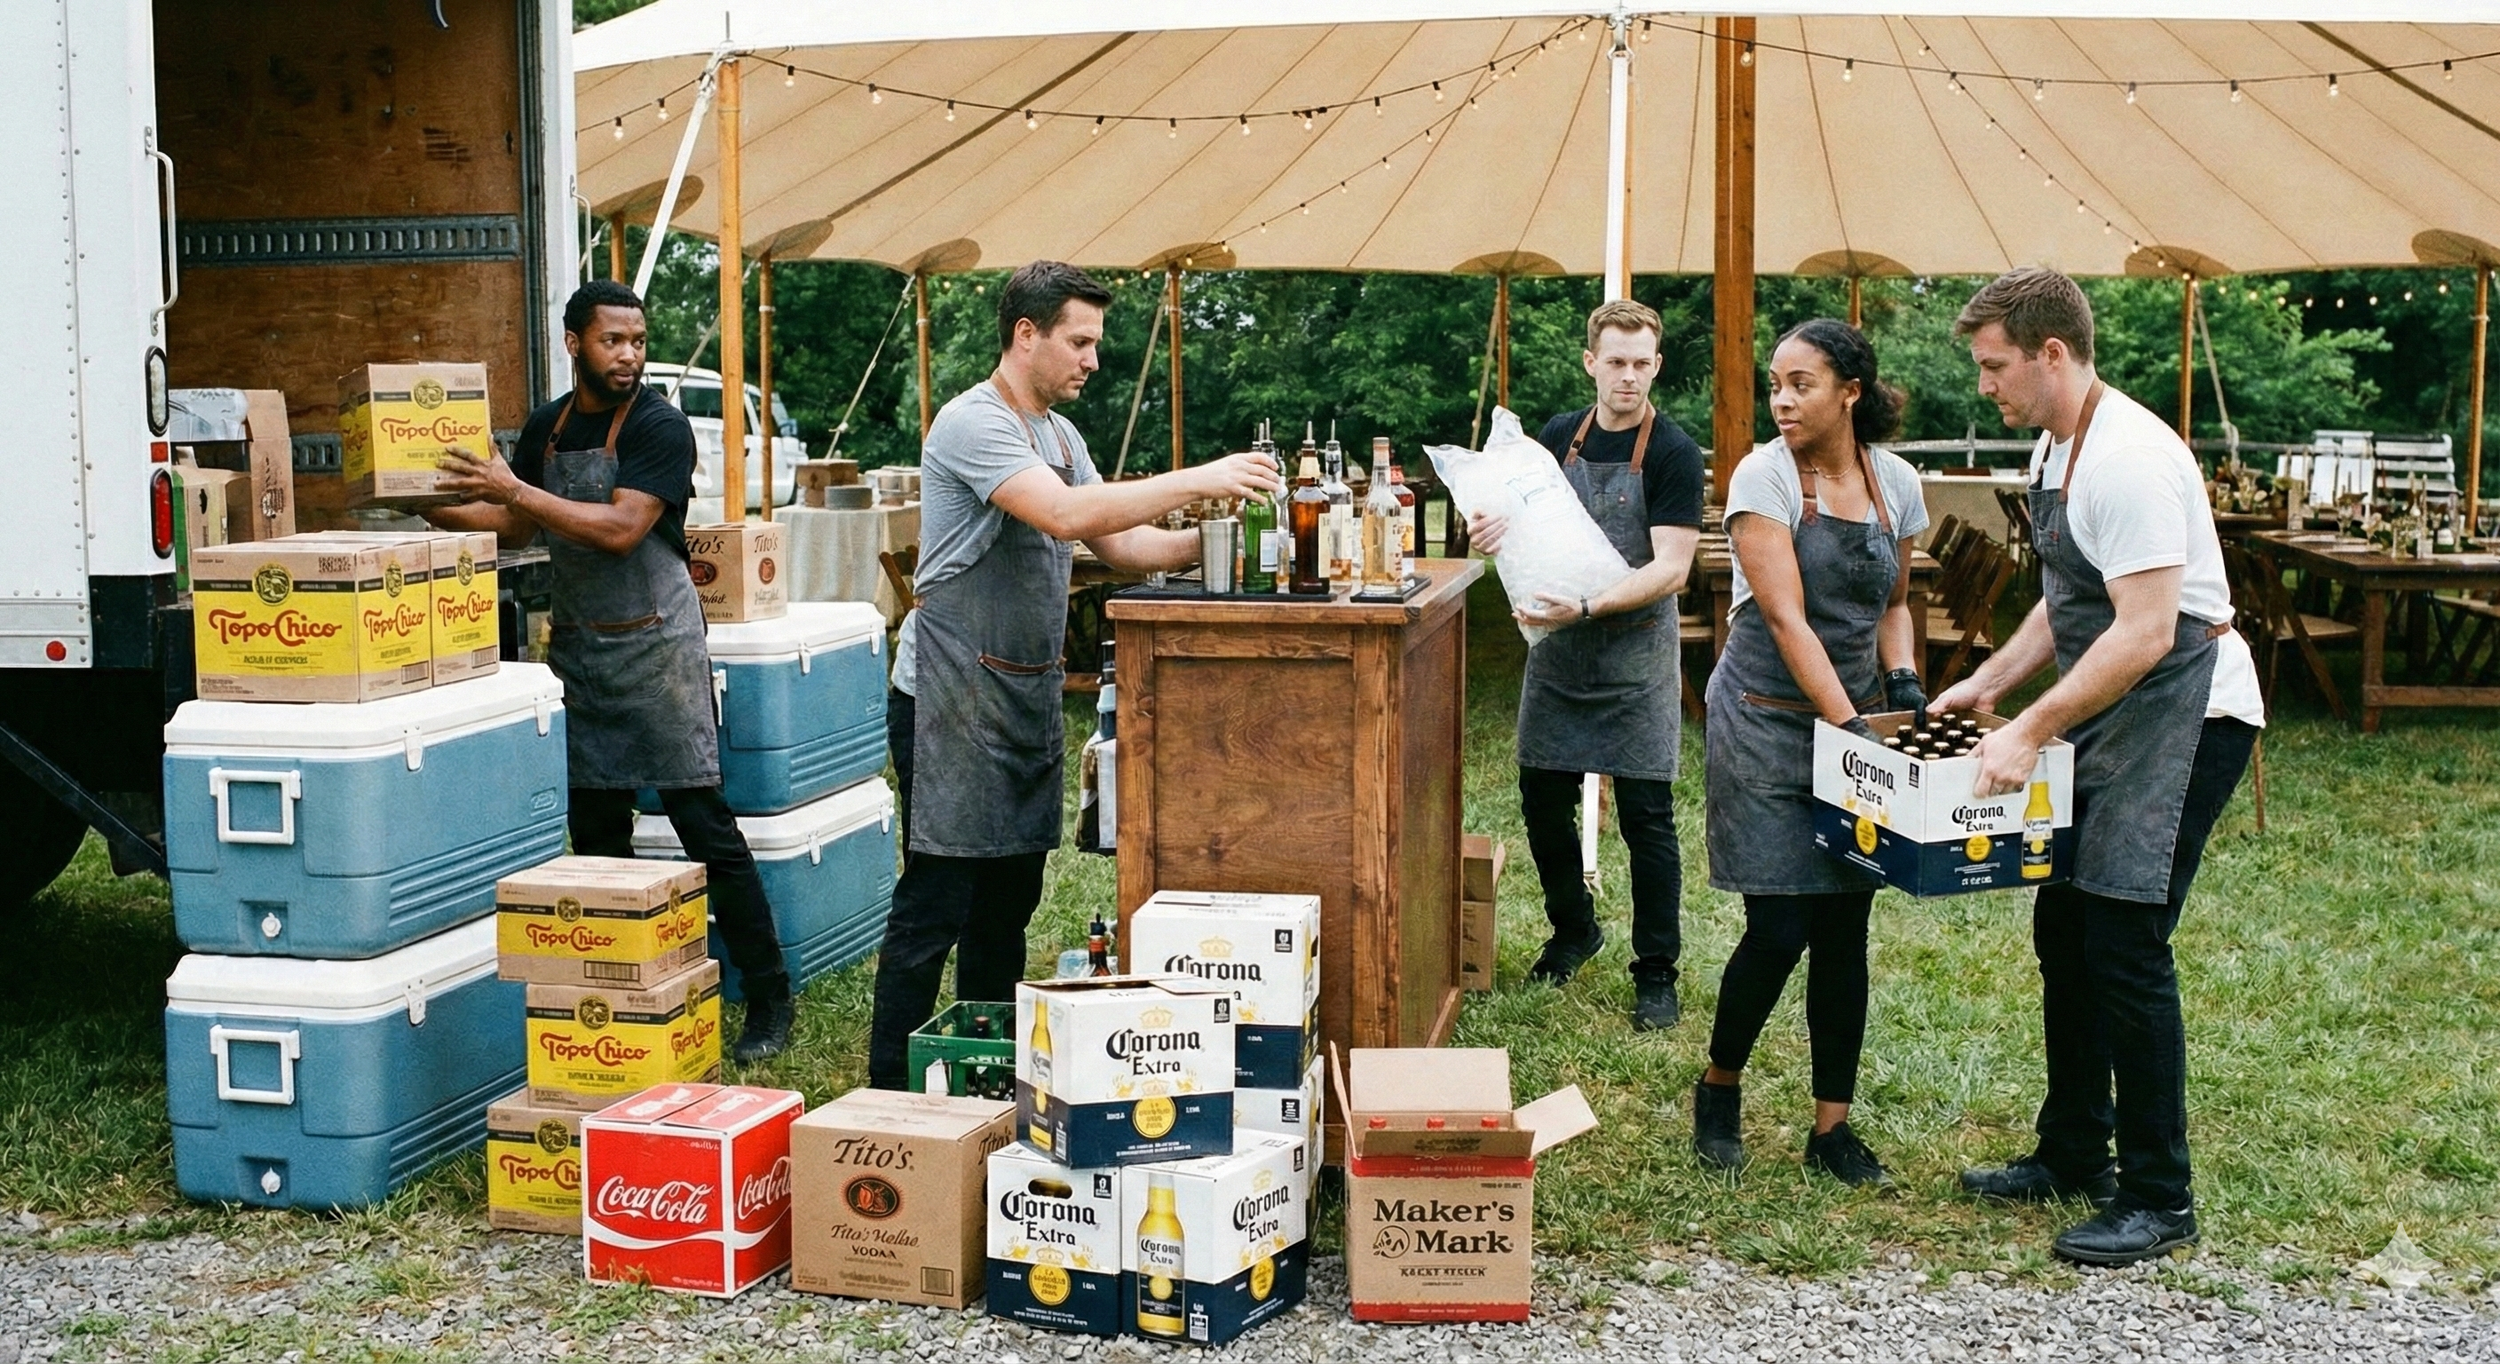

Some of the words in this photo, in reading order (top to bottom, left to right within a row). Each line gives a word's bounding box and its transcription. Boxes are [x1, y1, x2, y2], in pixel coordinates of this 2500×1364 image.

[380, 418, 432, 443] Topo
[433, 416, 484, 443] Chico
[754, 533, 778, 553] Tito's
[363, 609, 396, 642] Topo
[395, 603, 426, 637] Chico
[437, 596, 468, 627] Topo
[466, 590, 494, 622] Chico
[208, 609, 272, 645] Topo
[275, 609, 342, 647] Chico
[1842, 749, 1894, 790] Corona
[1856, 779, 1882, 806] Extra
[1952, 805, 2004, 825] Corona
[525, 923, 570, 948] Topo
[570, 926, 617, 951] Chico
[1164, 953, 1262, 981] Corona
[540, 1032, 595, 1061] Topo
[594, 1035, 651, 1067] Chico
[1106, 1028, 1201, 1061] Corona
[1132, 1056, 1181, 1076] Extra
[833, 1134, 914, 1170] Tito's
[499, 1154, 554, 1184] Topo
[554, 1159, 581, 1190] Chi
[597, 1175, 714, 1224] Coca-Cola
[1000, 1190, 1097, 1226] Corona
[1232, 1185, 1290, 1232] Corona
[1373, 1198, 1515, 1222] Maker's
[1026, 1220, 1076, 1246] Extra
[1248, 1218, 1279, 1243] Extra
[1414, 1229, 1513, 1254] Mark
[1141, 1238, 1181, 1255] Corona
